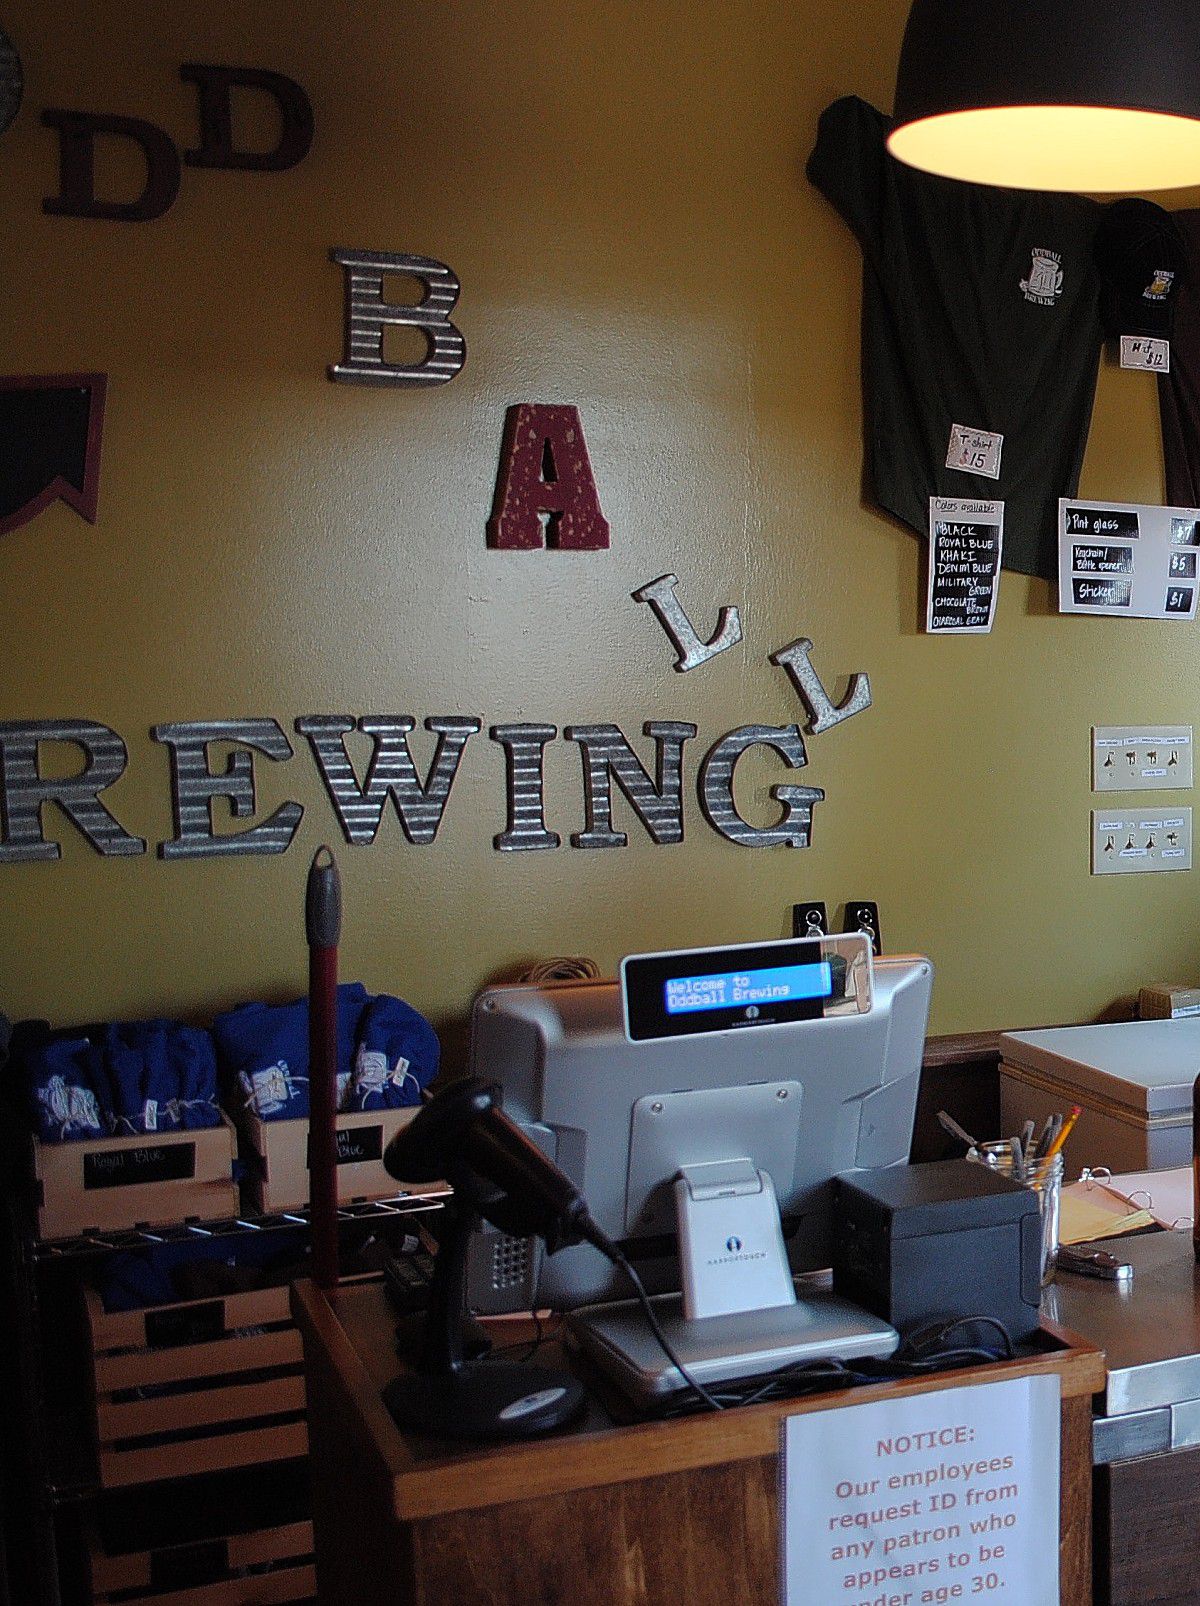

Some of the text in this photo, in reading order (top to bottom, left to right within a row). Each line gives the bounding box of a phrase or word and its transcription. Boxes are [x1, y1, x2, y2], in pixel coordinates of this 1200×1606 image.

[1072, 514, 1119, 533] Pint glass
[939, 537, 993, 549] ROYAL BLUE
[940, 550, 977, 561] KHAKI
[1172, 556, 1186, 571] $5
[972, 563, 993, 573] BLUE
[937, 577, 978, 587] MILITARY
[935, 597, 977, 607] CHOCOLATE
[667, 975, 750, 994] Welcome to
[669, 983, 791, 1008] Oddball Brewing
[876, 1425, 975, 1457] NOTICE:
[835, 1454, 1014, 1499] Our employees
[828, 1483, 1019, 1531] request ID from
[831, 1511, 1017, 1561] any patron who
[843, 1544, 1006, 1590] appears to be
[845, 1571, 1005, 1606] nder age 30.
